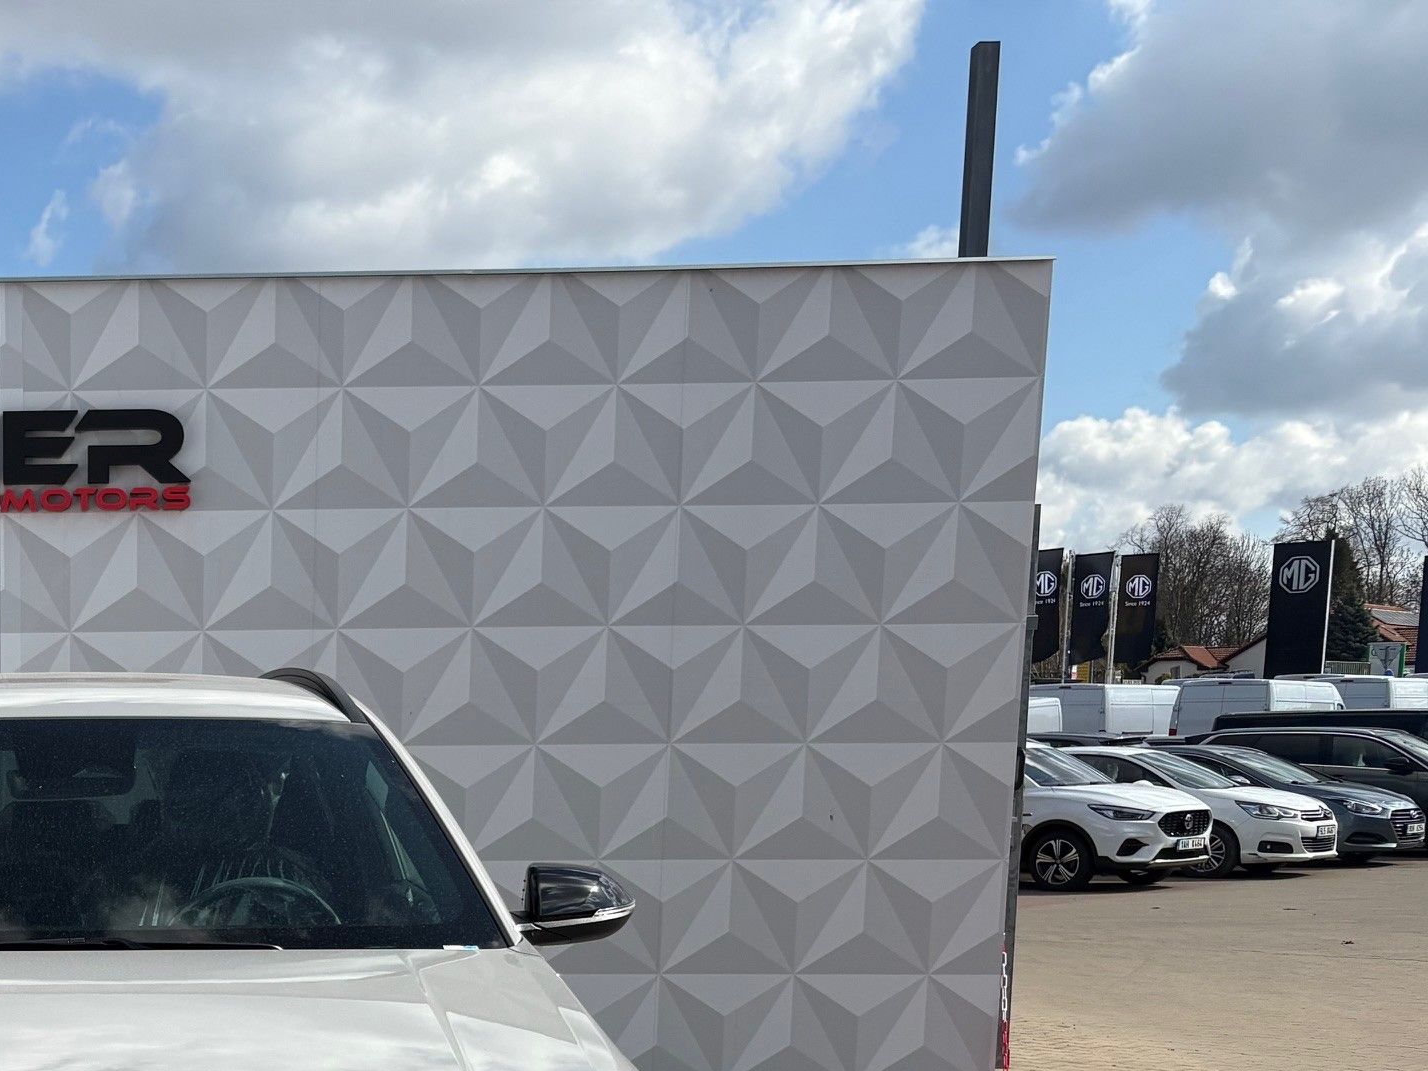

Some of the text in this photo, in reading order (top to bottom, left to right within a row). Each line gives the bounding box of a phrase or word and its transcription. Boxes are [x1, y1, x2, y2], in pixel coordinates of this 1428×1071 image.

[0, 485, 192, 514] MOTORS
[1082, 575, 1104, 597] MG
[1128, 576, 1151, 597] MG
[1282, 558, 1316, 591] MG
